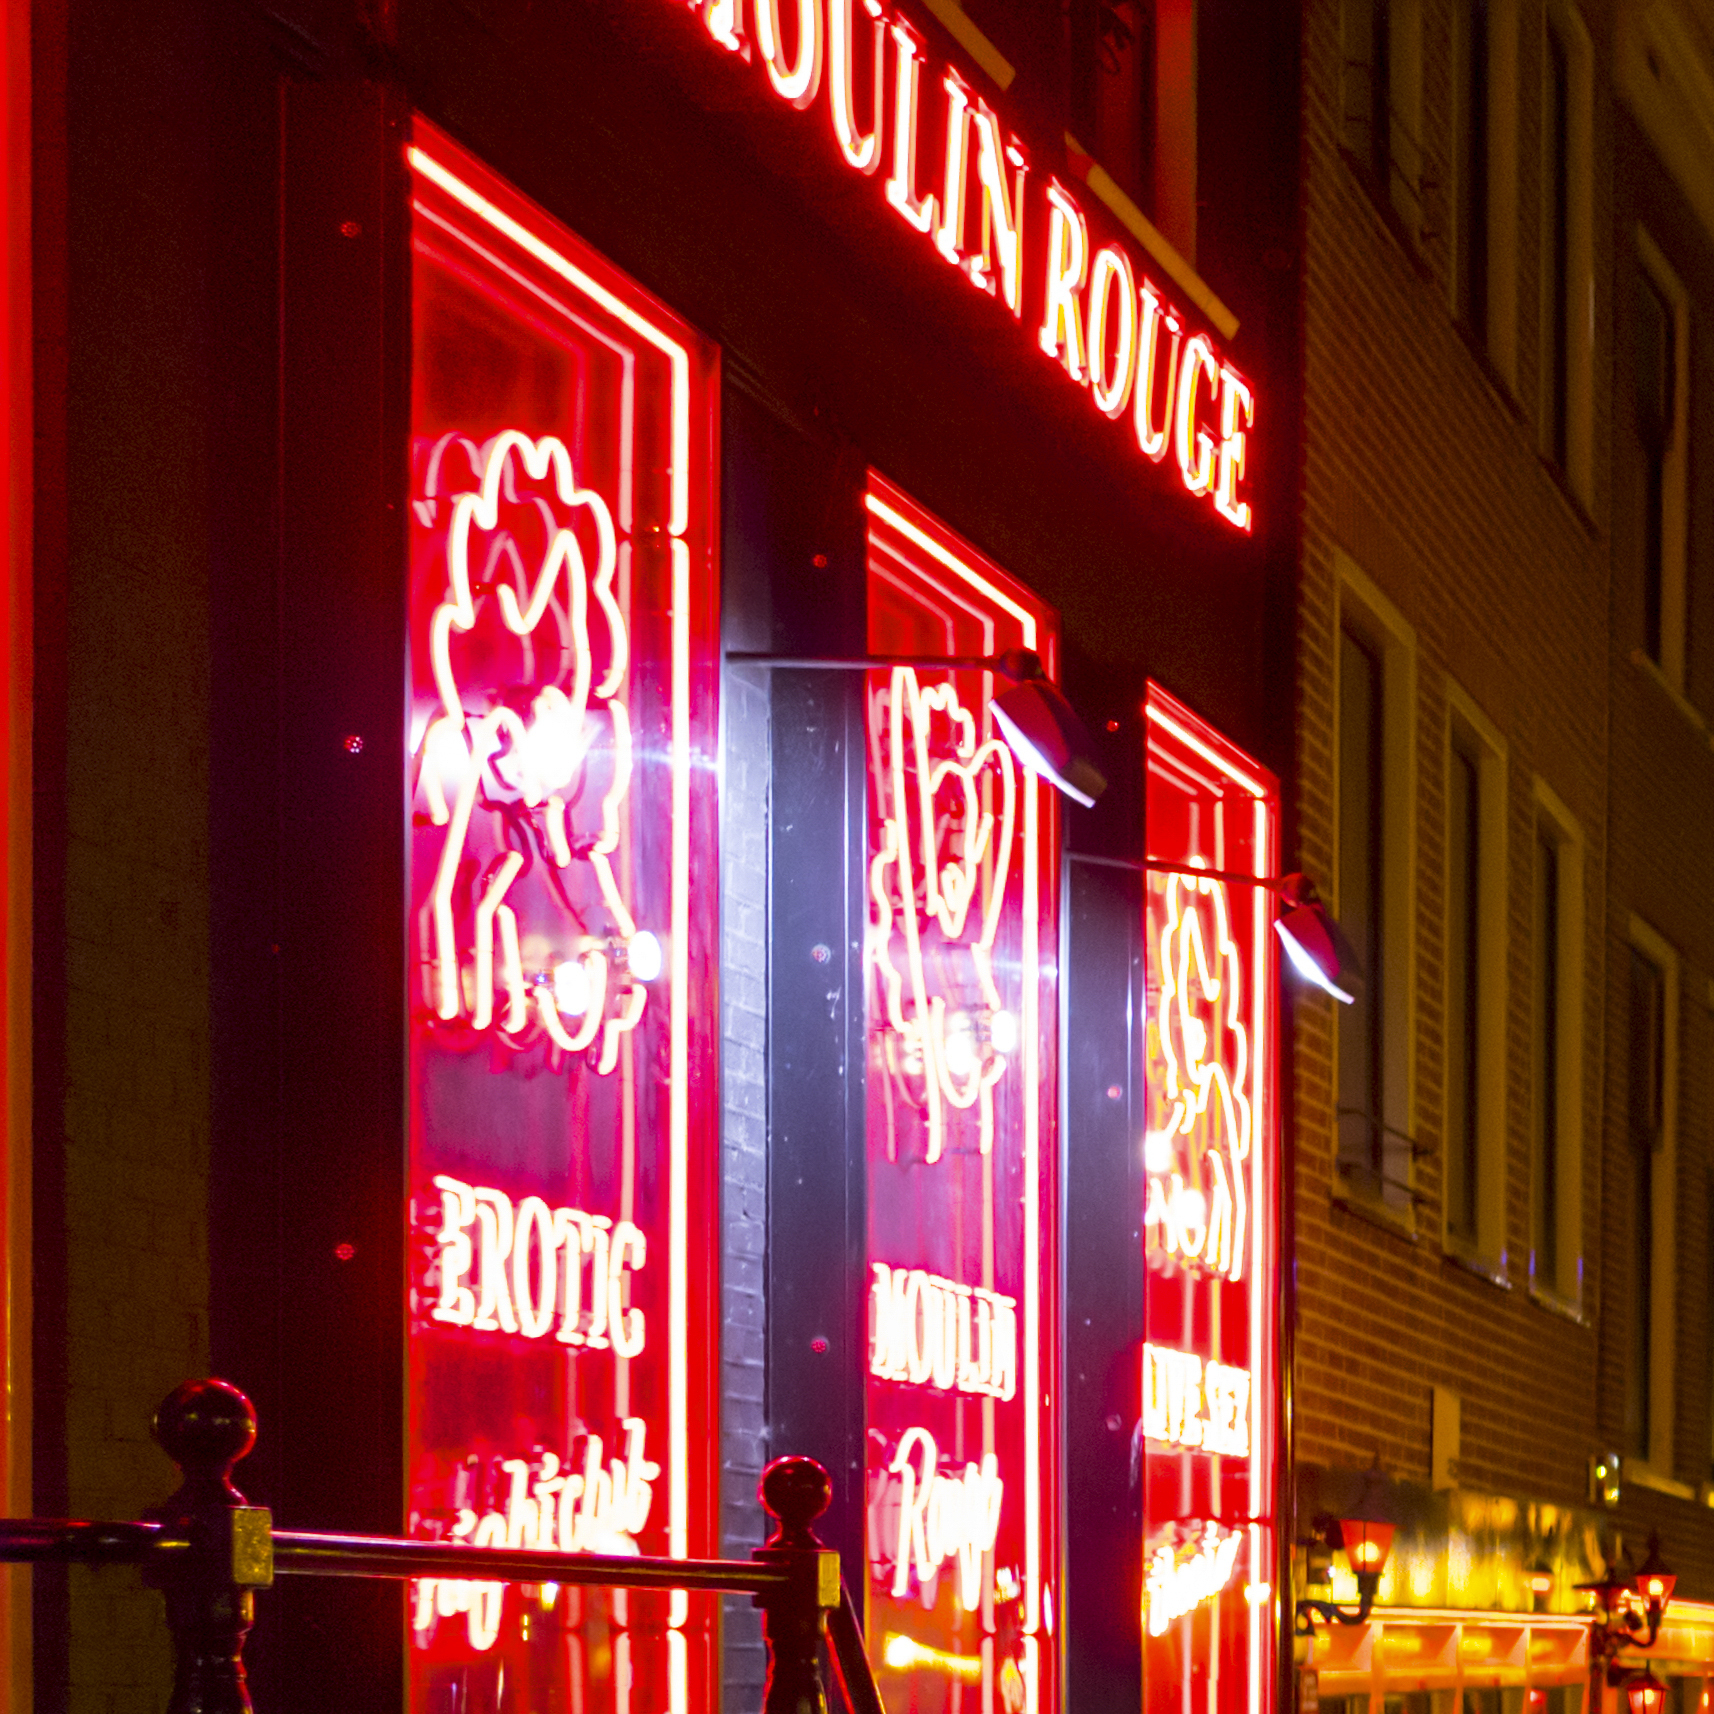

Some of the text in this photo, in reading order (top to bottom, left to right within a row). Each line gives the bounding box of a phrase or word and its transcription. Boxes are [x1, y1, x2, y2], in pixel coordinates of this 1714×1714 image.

[1040, 175, 1255, 537] ROUGE
[432, 1174, 648, 1360] EROTIC
[872, 1262, 1016, 1402] MOULIN
